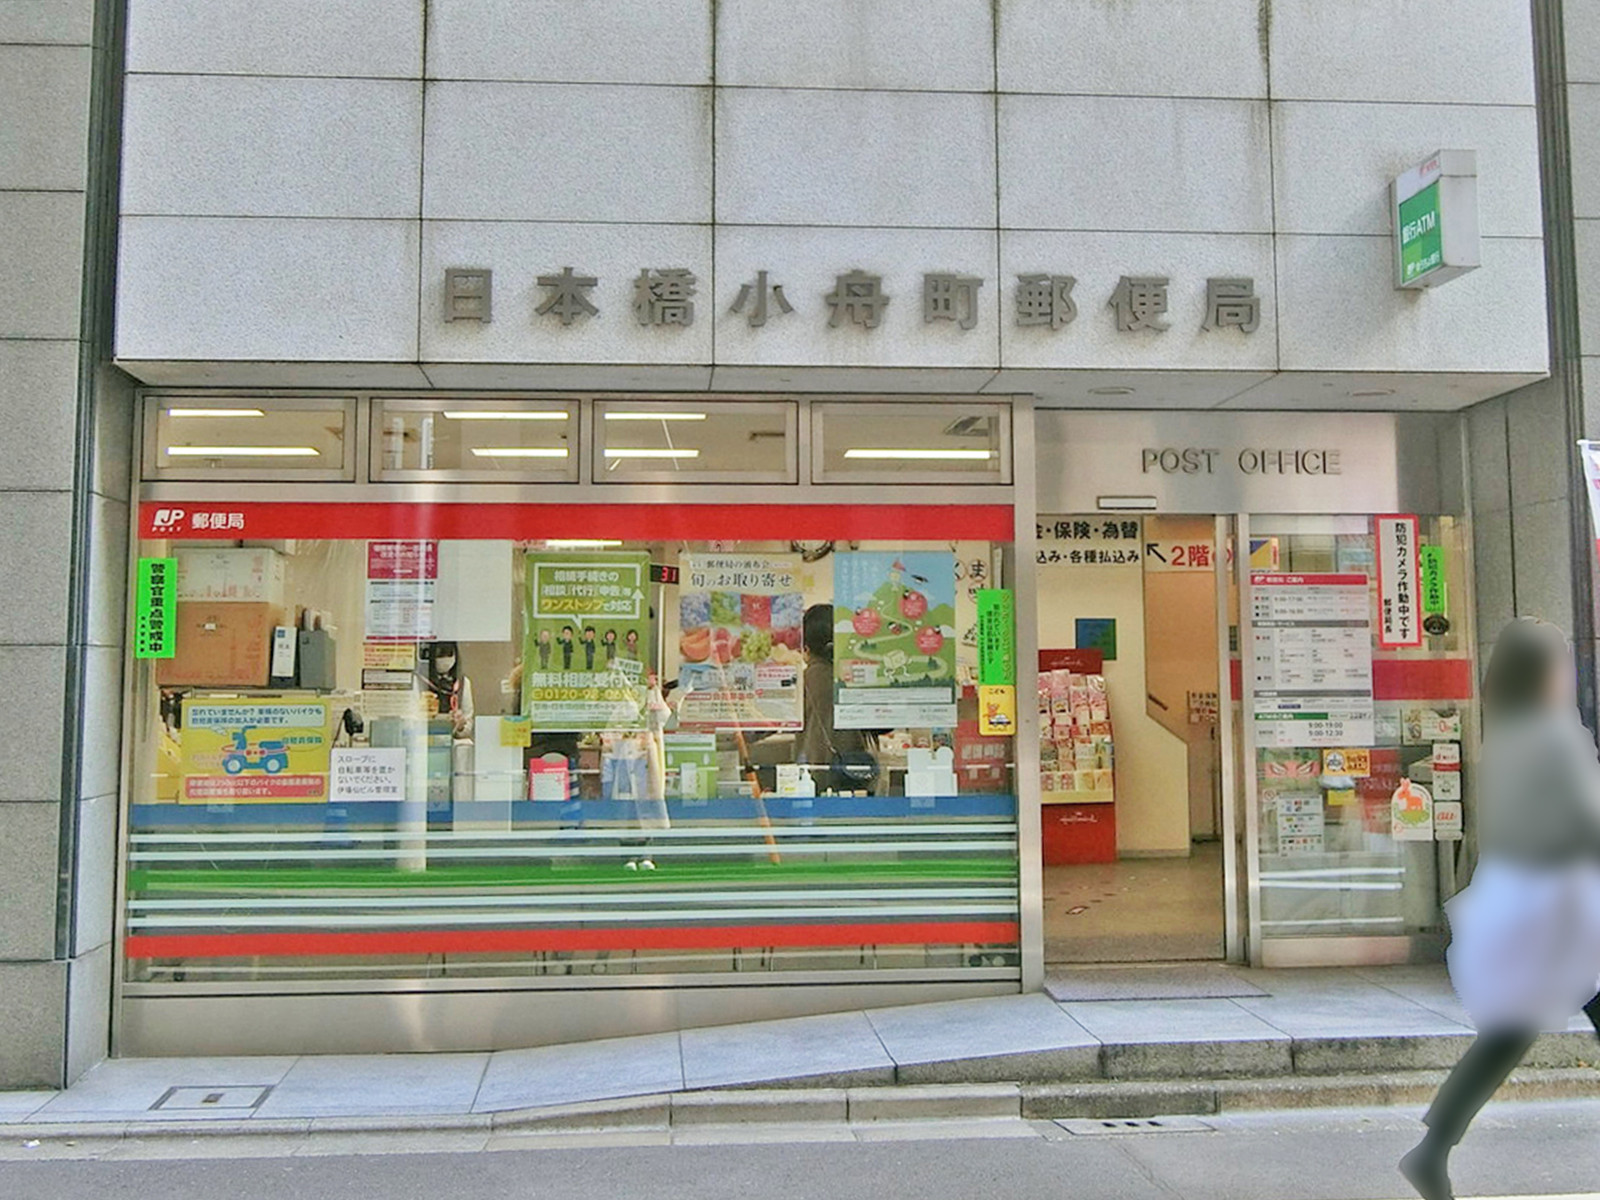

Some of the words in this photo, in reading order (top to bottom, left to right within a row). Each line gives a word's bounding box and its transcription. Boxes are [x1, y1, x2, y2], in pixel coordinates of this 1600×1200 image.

[444, 266, 1261, 335] 日本橋小舟町郵便局
[1141, 447, 1220, 475] POST
[1238, 447, 1342, 475] OFFICE
[191, 512, 245, 530] 郵便局
[691, 571, 793, 588] 旬のお取り寄せ
[1395, 522, 1410, 640] 防犯カメラ作動中です
[337, 755, 377, 763] スロープに
